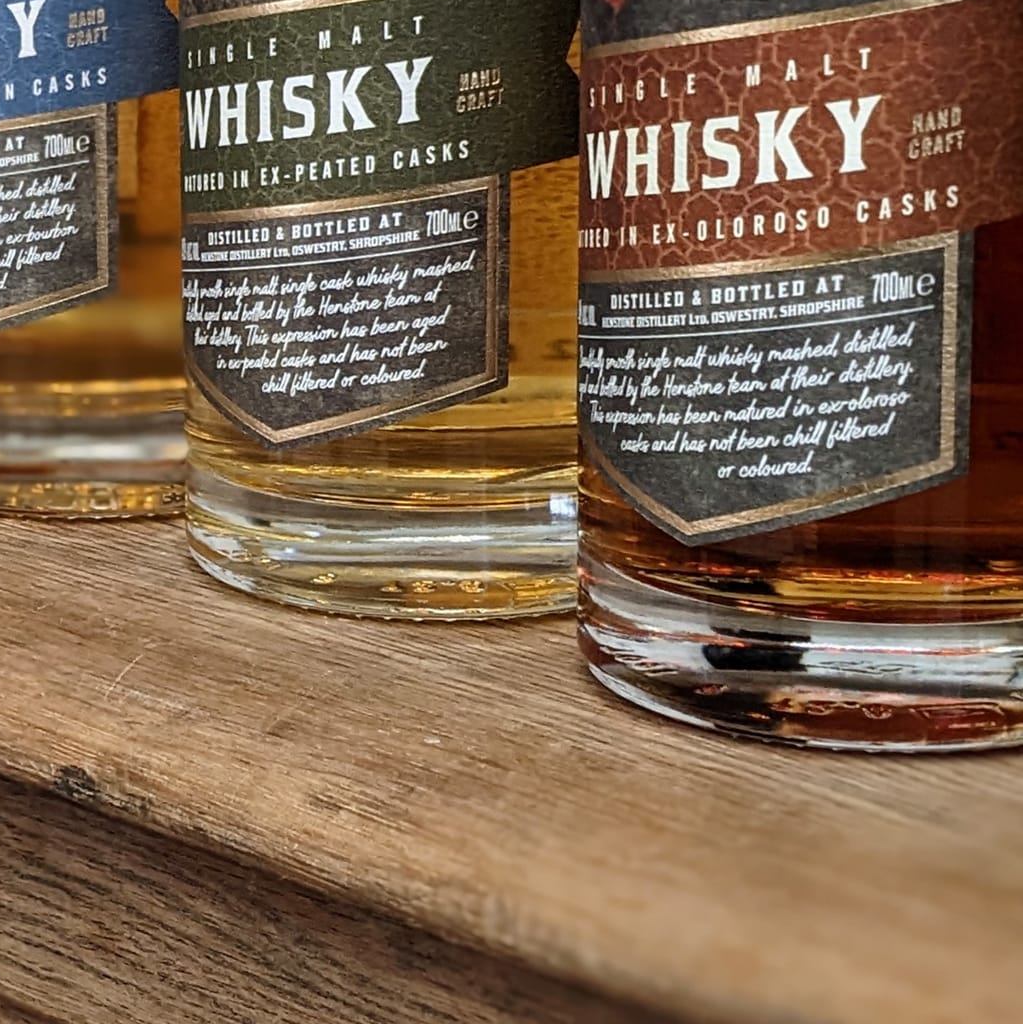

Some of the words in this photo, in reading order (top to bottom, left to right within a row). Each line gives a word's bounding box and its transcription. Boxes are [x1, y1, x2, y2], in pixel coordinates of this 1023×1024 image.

[68, 8, 105, 28] HAND
[66, 26, 108, 48] CRAFT
[187, 37, 277, 68] SINGLE
[318, 15, 426, 49] MALT
[33, 67, 107, 96] CASKS
[459, 68, 501, 92] HAND
[589, 75, 698, 109] SINGLE
[746, 46, 872, 88] MALT
[186, 56, 434, 150] WHISKY
[456, 88, 504, 113] CRAFT
[912, 106, 962, 135] HAND
[4, 136, 25, 151] AT
[585, 95, 883, 200] WHISKY
[908, 129, 965, 159] CRAFT
[233, 170, 249, 188] IN
[260, 154, 375, 187] EX-PEATED
[393, 139, 470, 170] CASKS
[208, 228, 270, 245] DISTILLED
[276, 227, 284, 241] &
[292, 215, 369, 240] BOTTLED
[378, 212, 403, 229] AT
[620, 227, 637, 247] IN
[652, 205, 830, 245] EX-OLOROSO
[856, 185, 960, 223] CASKS
[16, 242, 64, 270] filtered
[230, 248, 271, 261] DISTILLERY
[349, 230, 421, 250] SHROPSHIRE
[224, 277, 251, 305] single
[281, 272, 316, 302] single
[320, 271, 353, 291] cask
[357, 264, 408, 289] whisky
[610, 291, 685, 310] DISTILLED
[691, 290, 702, 306] &
[711, 280, 804, 305] BOTTLED
[815, 275, 844, 294] AT
[222, 301, 242, 320] and
[242, 301, 275, 322] bottled
[276, 302, 290, 327] by
[294, 297, 315, 319] the
[318, 295, 382, 316] Henstone
[384, 288, 421, 309] team
[424, 281, 442, 303] at
[636, 314, 687, 328] DISTILLERY
[779, 295, 865, 317] SHROPSHIRE
[245, 325, 270, 346] This
[272, 325, 337, 351] expression
[340, 320, 368, 339] has
[370, 316, 409, 336] been
[412, 304, 452, 337] aged
[281, 350, 316, 368] casks
[319, 344, 349, 364] and
[350, 344, 378, 364] has
[381, 336, 408, 358] not
[408, 337, 448, 356] been
[637, 347, 672, 379] single
[674, 345, 707, 369] malt
[708, 344, 763, 374] whisky
[262, 372, 287, 393] chill
[290, 369, 340, 396] filtered
[341, 375, 357, 387] or
[626, 378, 637, 406] by
[640, 373, 661, 398] the
[663, 374, 724, 398] Henstone
[727, 372, 767, 395] team
[771, 369, 789, 392] at
[792, 365, 835, 389] their
[605, 408, 656, 432] expression
[657, 404, 681, 425] has
[683, 402, 720, 424] been
[723, 394, 792, 423] matured
[792, 398, 814, 417] in
[818, 386, 911, 413] ex-oloroso
[620, 433, 650, 452] casks
[651, 430, 680, 452] and
[679, 432, 706, 453] has
[709, 428, 737, 451] not
[736, 429, 779, 451] been
[783, 420, 827, 446] chill
[826, 411, 896, 449] filtered
[717, 464, 733, 478] or
